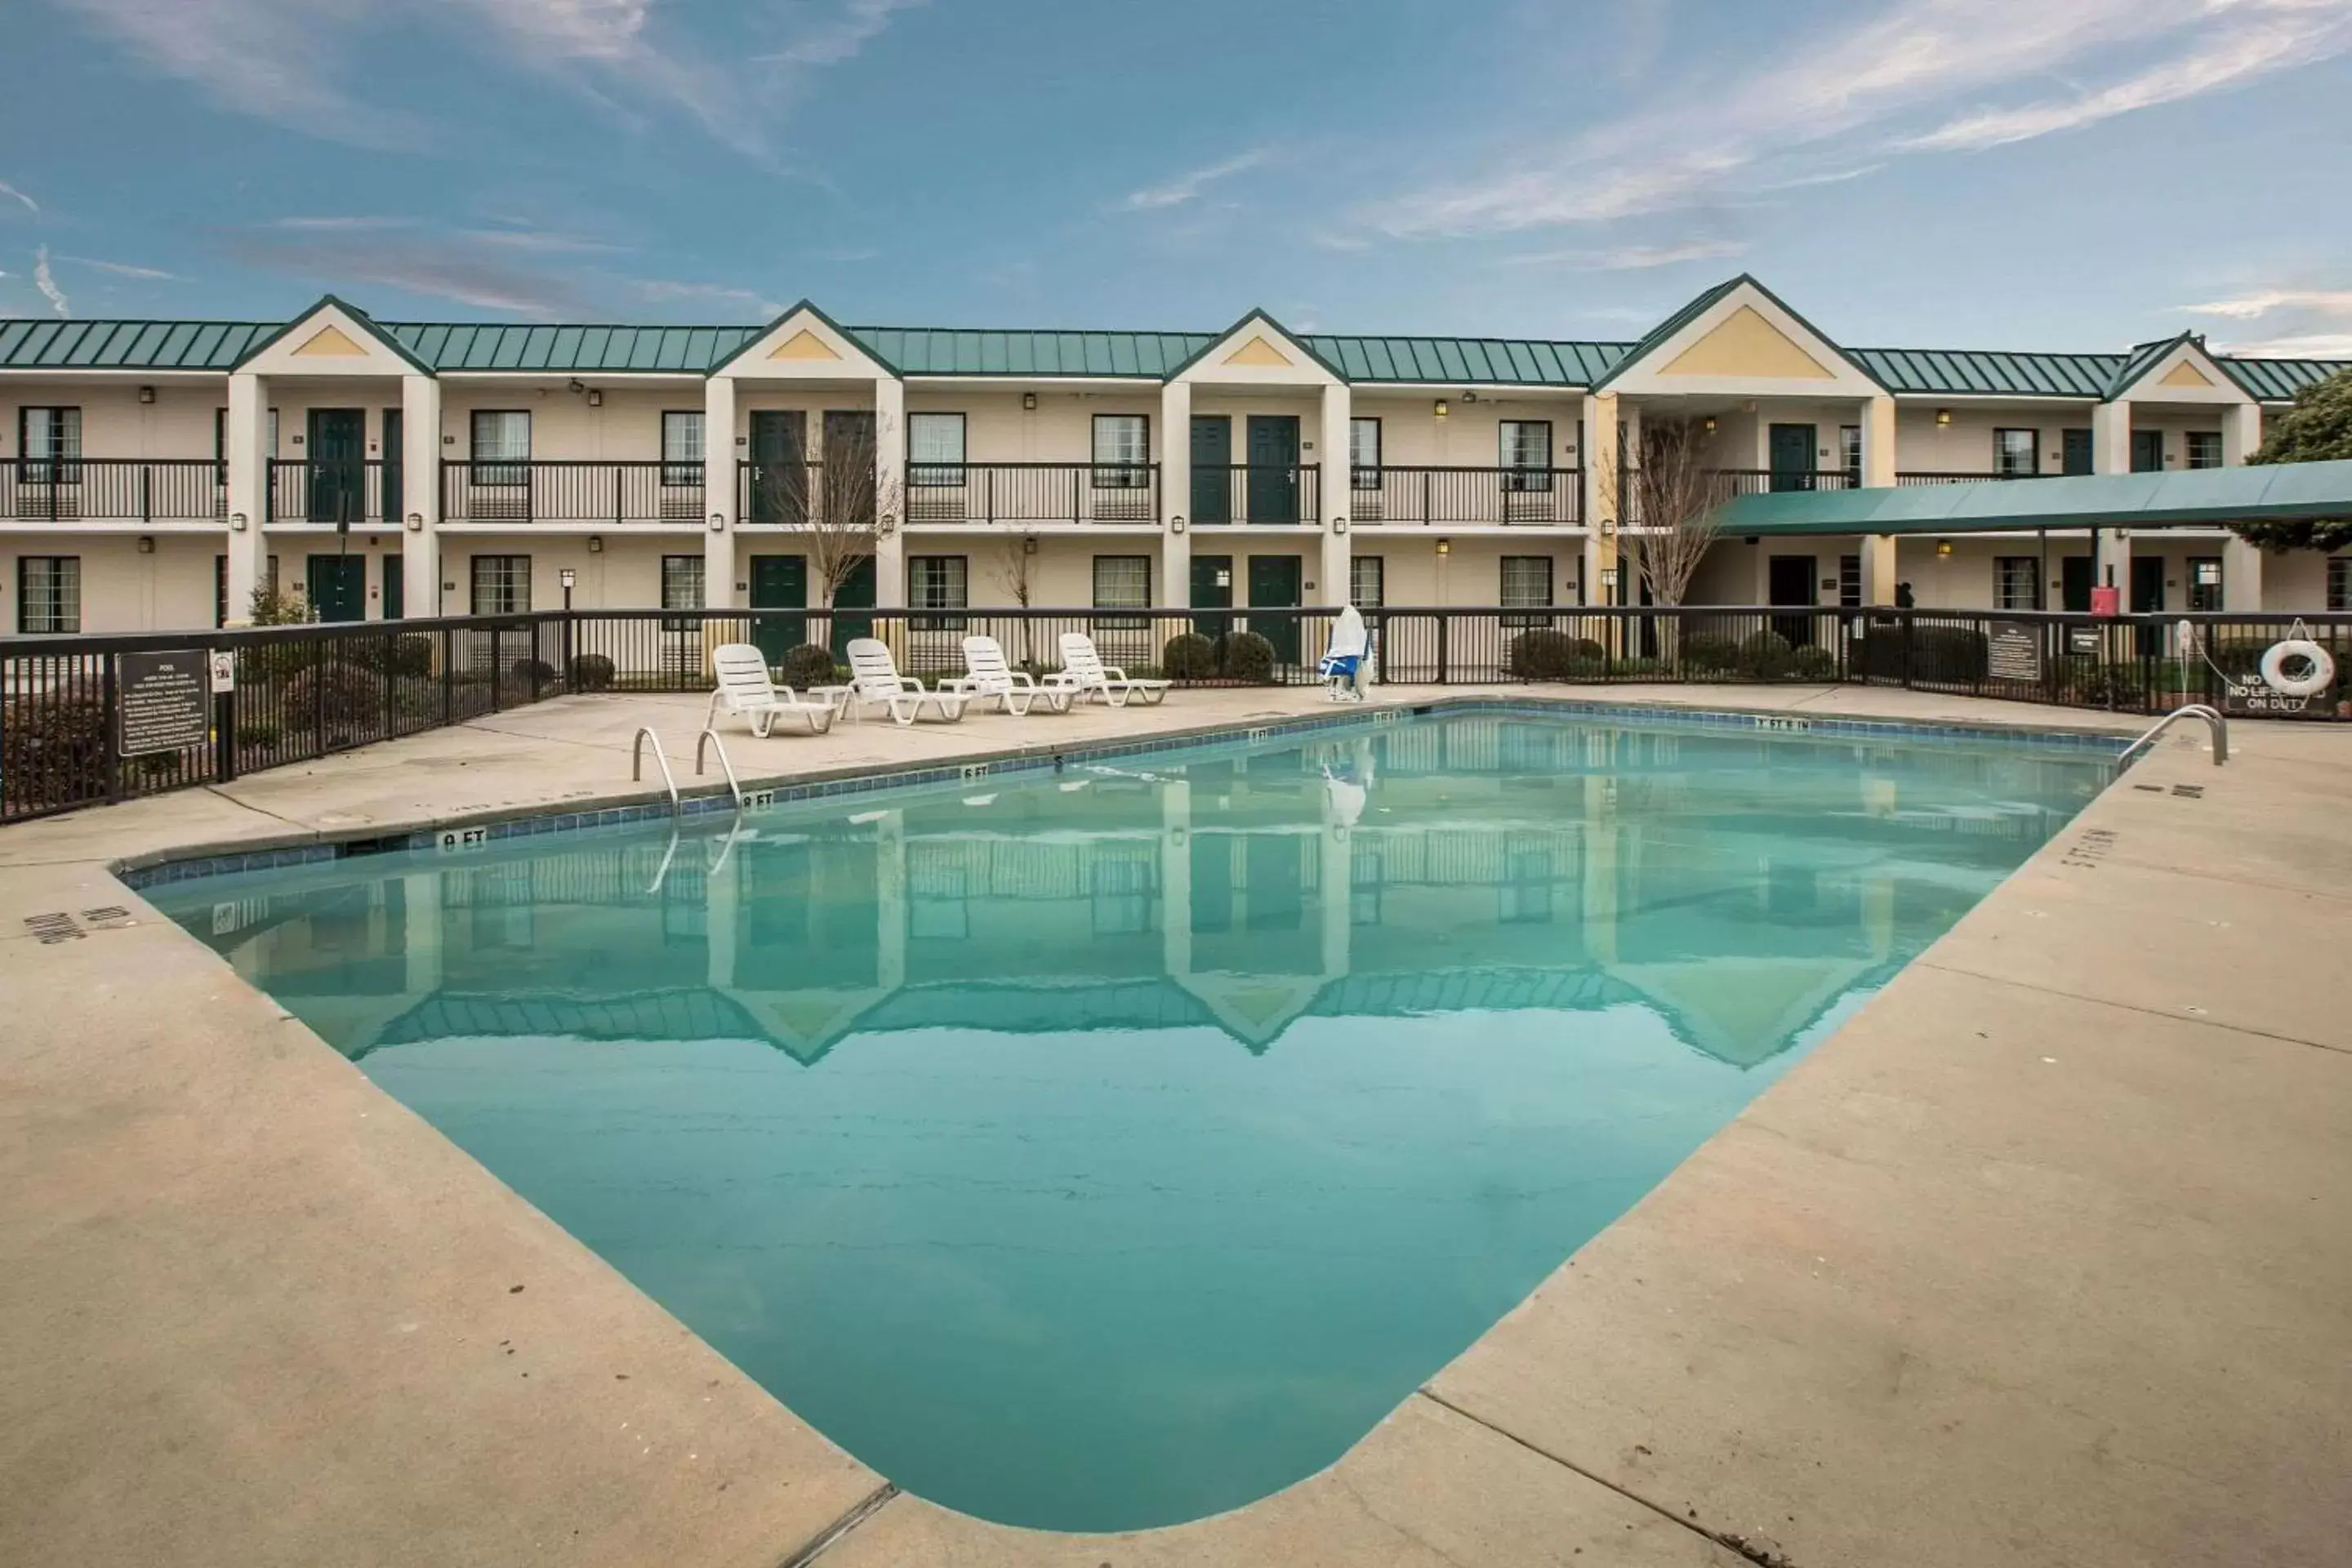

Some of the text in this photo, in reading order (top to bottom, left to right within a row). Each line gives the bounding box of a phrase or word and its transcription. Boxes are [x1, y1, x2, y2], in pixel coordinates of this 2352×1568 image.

[2242, 675, 2262, 685] NO
[2230, 686, 2248, 697] NO
[2247, 698, 2306, 710] ON DUTY
[757, 793, 772, 804] FT
[463, 829, 484, 843] FT
